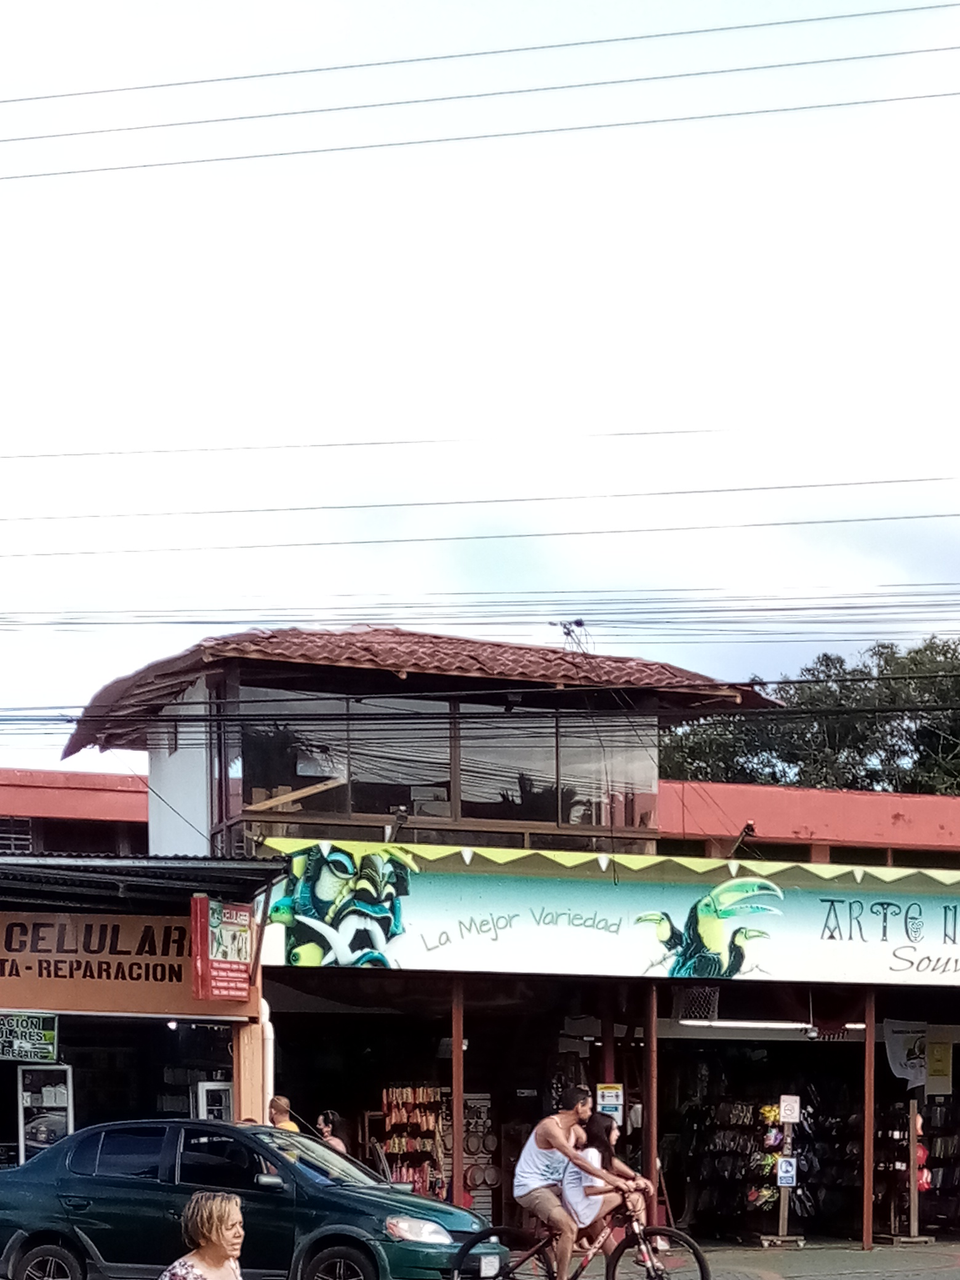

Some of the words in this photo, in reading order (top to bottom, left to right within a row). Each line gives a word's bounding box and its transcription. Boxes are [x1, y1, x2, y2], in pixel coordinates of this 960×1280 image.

[420, 931, 453, 952] La
[458, 912, 520, 942] Mejor
[529, 906, 624, 936] Variedad
[819, 898, 924, 943] ARTE
[4, 922, 191, 957] CELULAR
[37, 958, 183, 983] REPARACION
[5, 1048, 39, 1060] REPAIR
